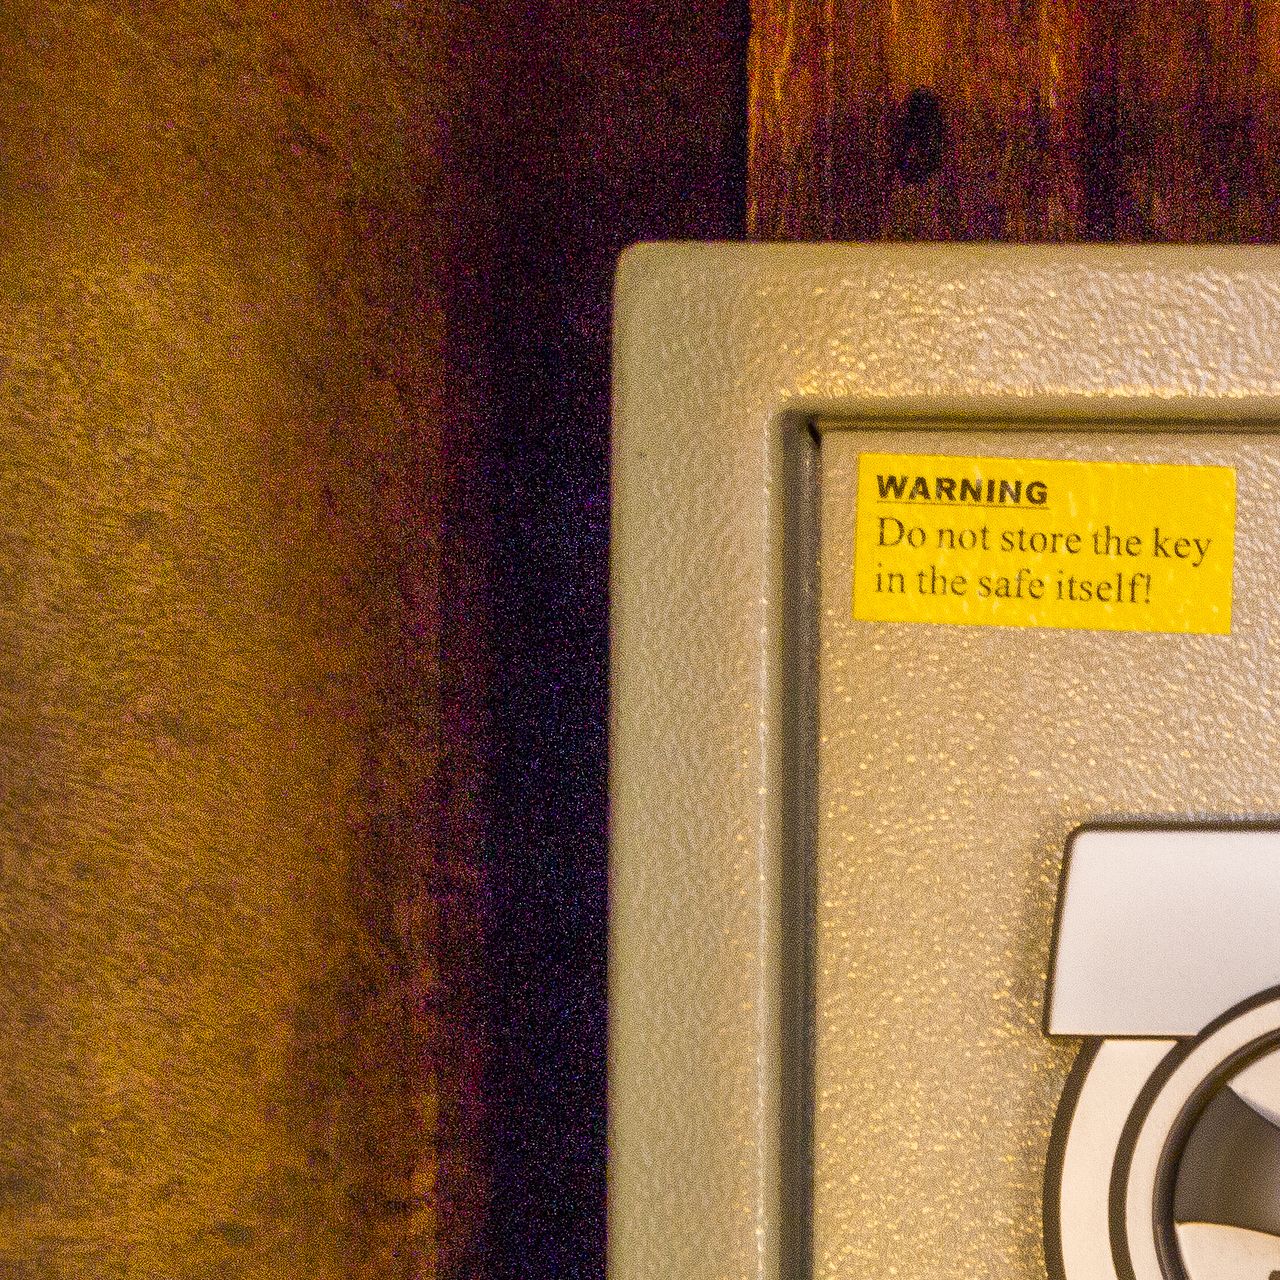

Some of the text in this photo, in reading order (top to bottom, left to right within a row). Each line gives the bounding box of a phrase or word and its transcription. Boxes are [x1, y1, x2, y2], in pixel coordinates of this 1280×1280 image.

[877, 473, 1049, 506] WARNING
[878, 516, 1212, 568] Do not store the key
[876, 562, 1152, 605] in the safe itself!
